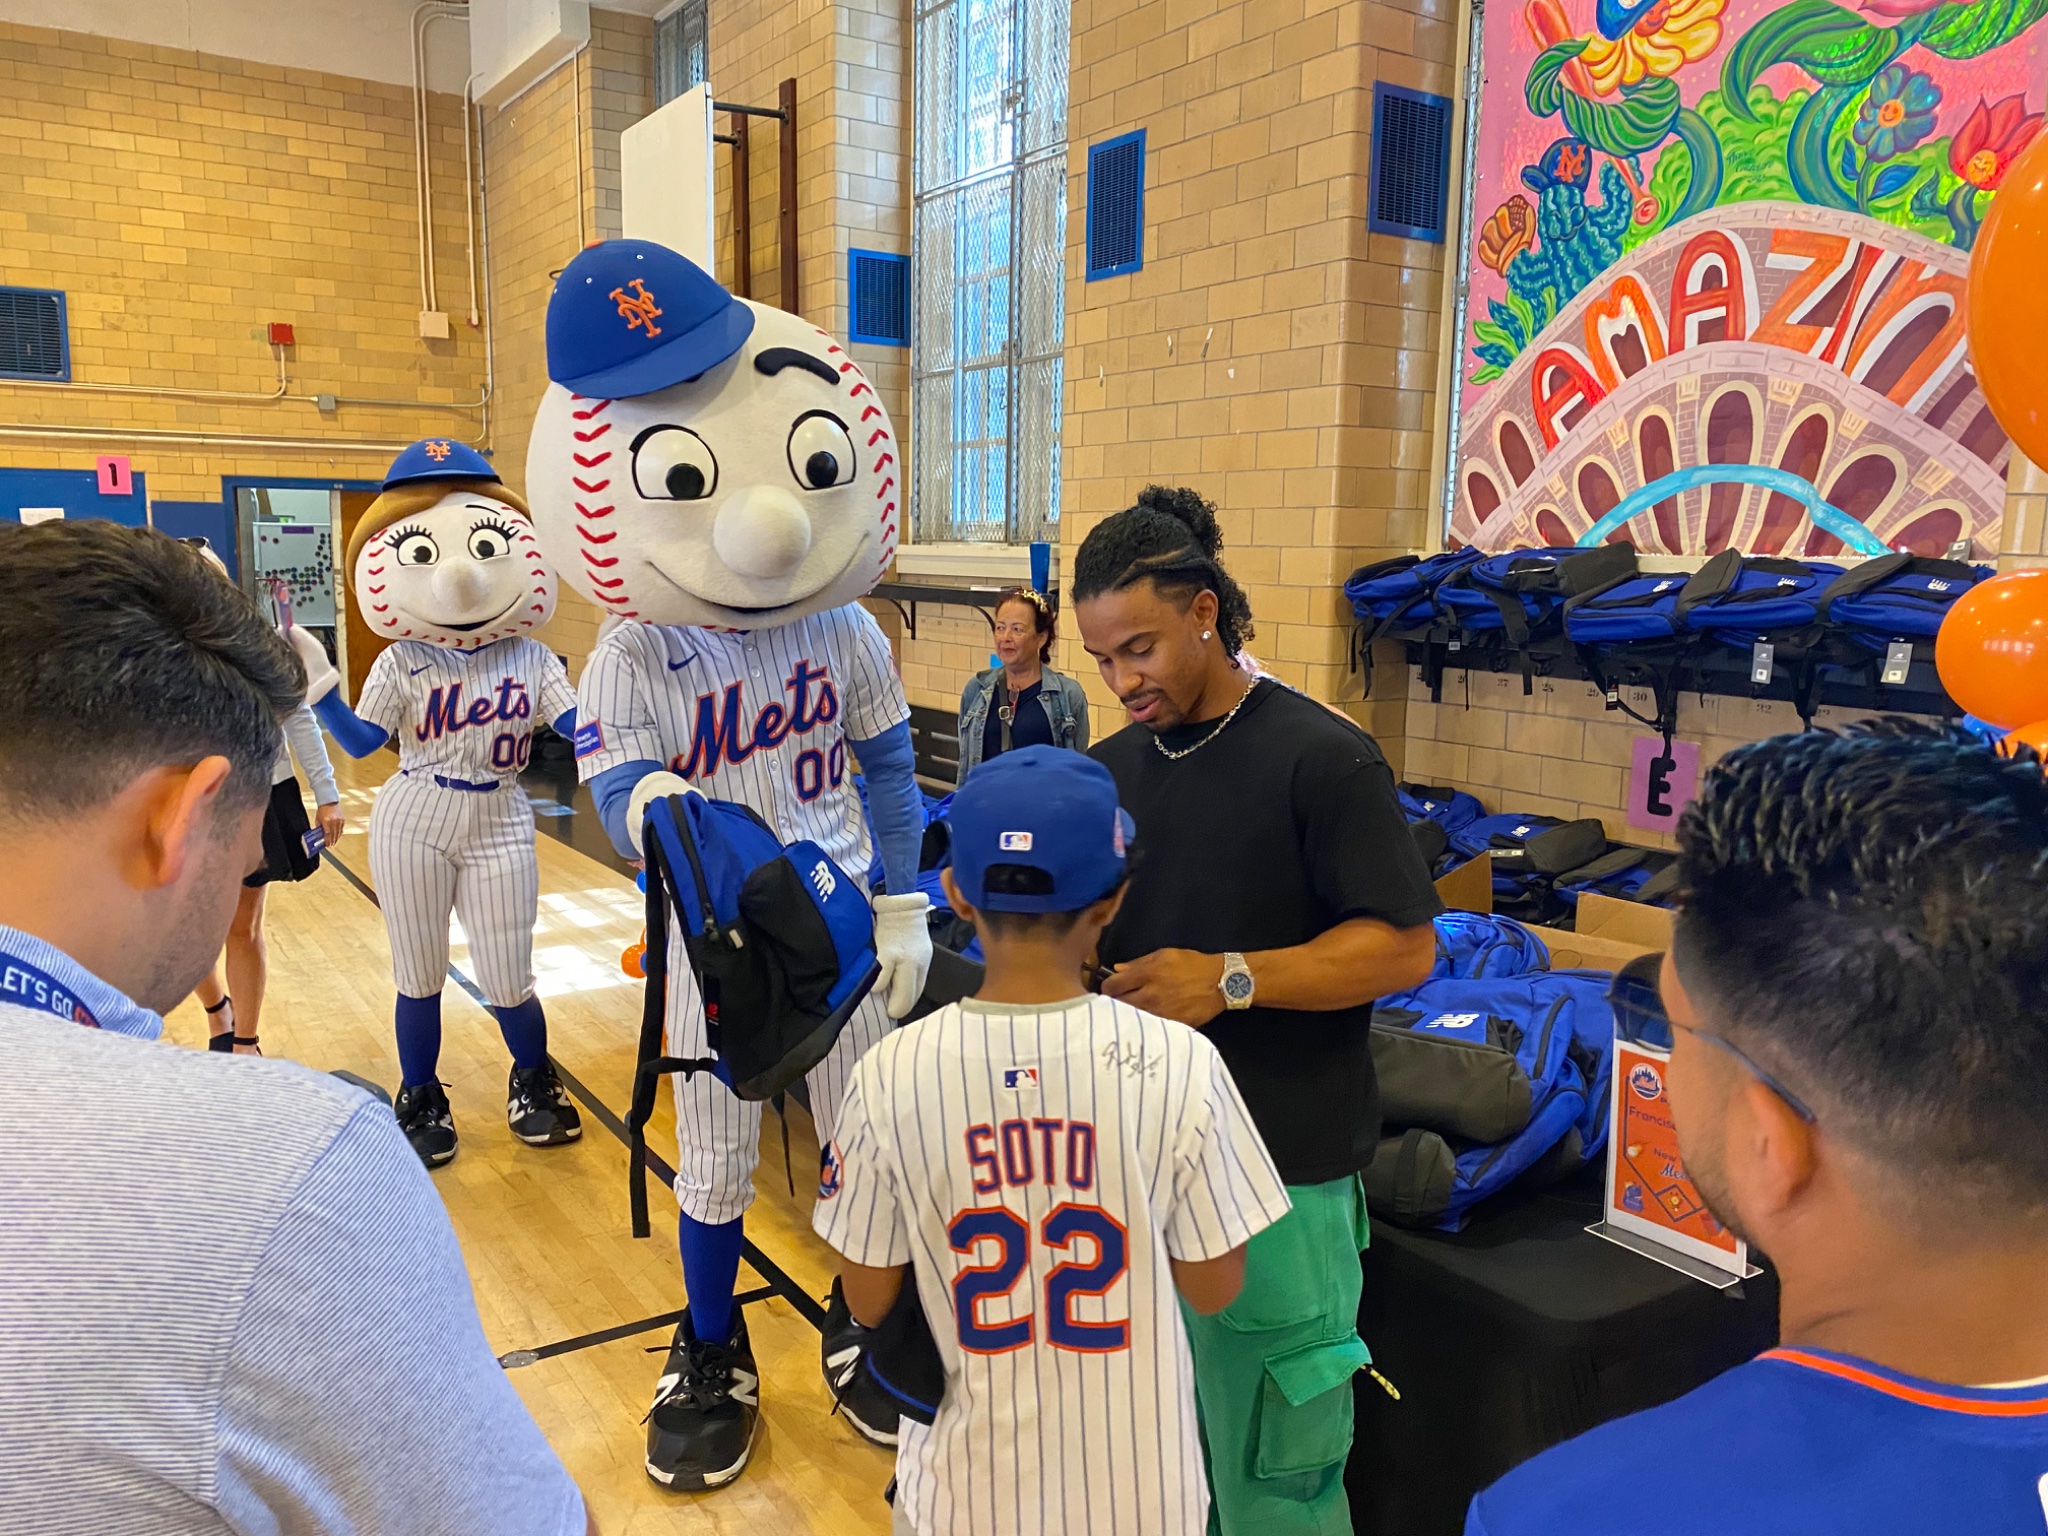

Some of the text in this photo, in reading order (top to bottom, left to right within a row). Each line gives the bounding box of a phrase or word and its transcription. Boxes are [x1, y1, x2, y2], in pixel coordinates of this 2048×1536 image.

[108, 463, 118, 487] 1
[416, 677, 531, 742] Mets
[669, 659, 838, 782] Mets
[1633, 692, 1648, 702] 30
[491, 731, 532, 769] 00
[794, 737, 844, 804] 00
[1647, 757, 1677, 817] E
[0, 966, 48, 1004] ET'S
[51, 990, 73, 1021] GO
[964, 1117, 1095, 1195] SOTO
[947, 1201, 1130, 1355] 22
